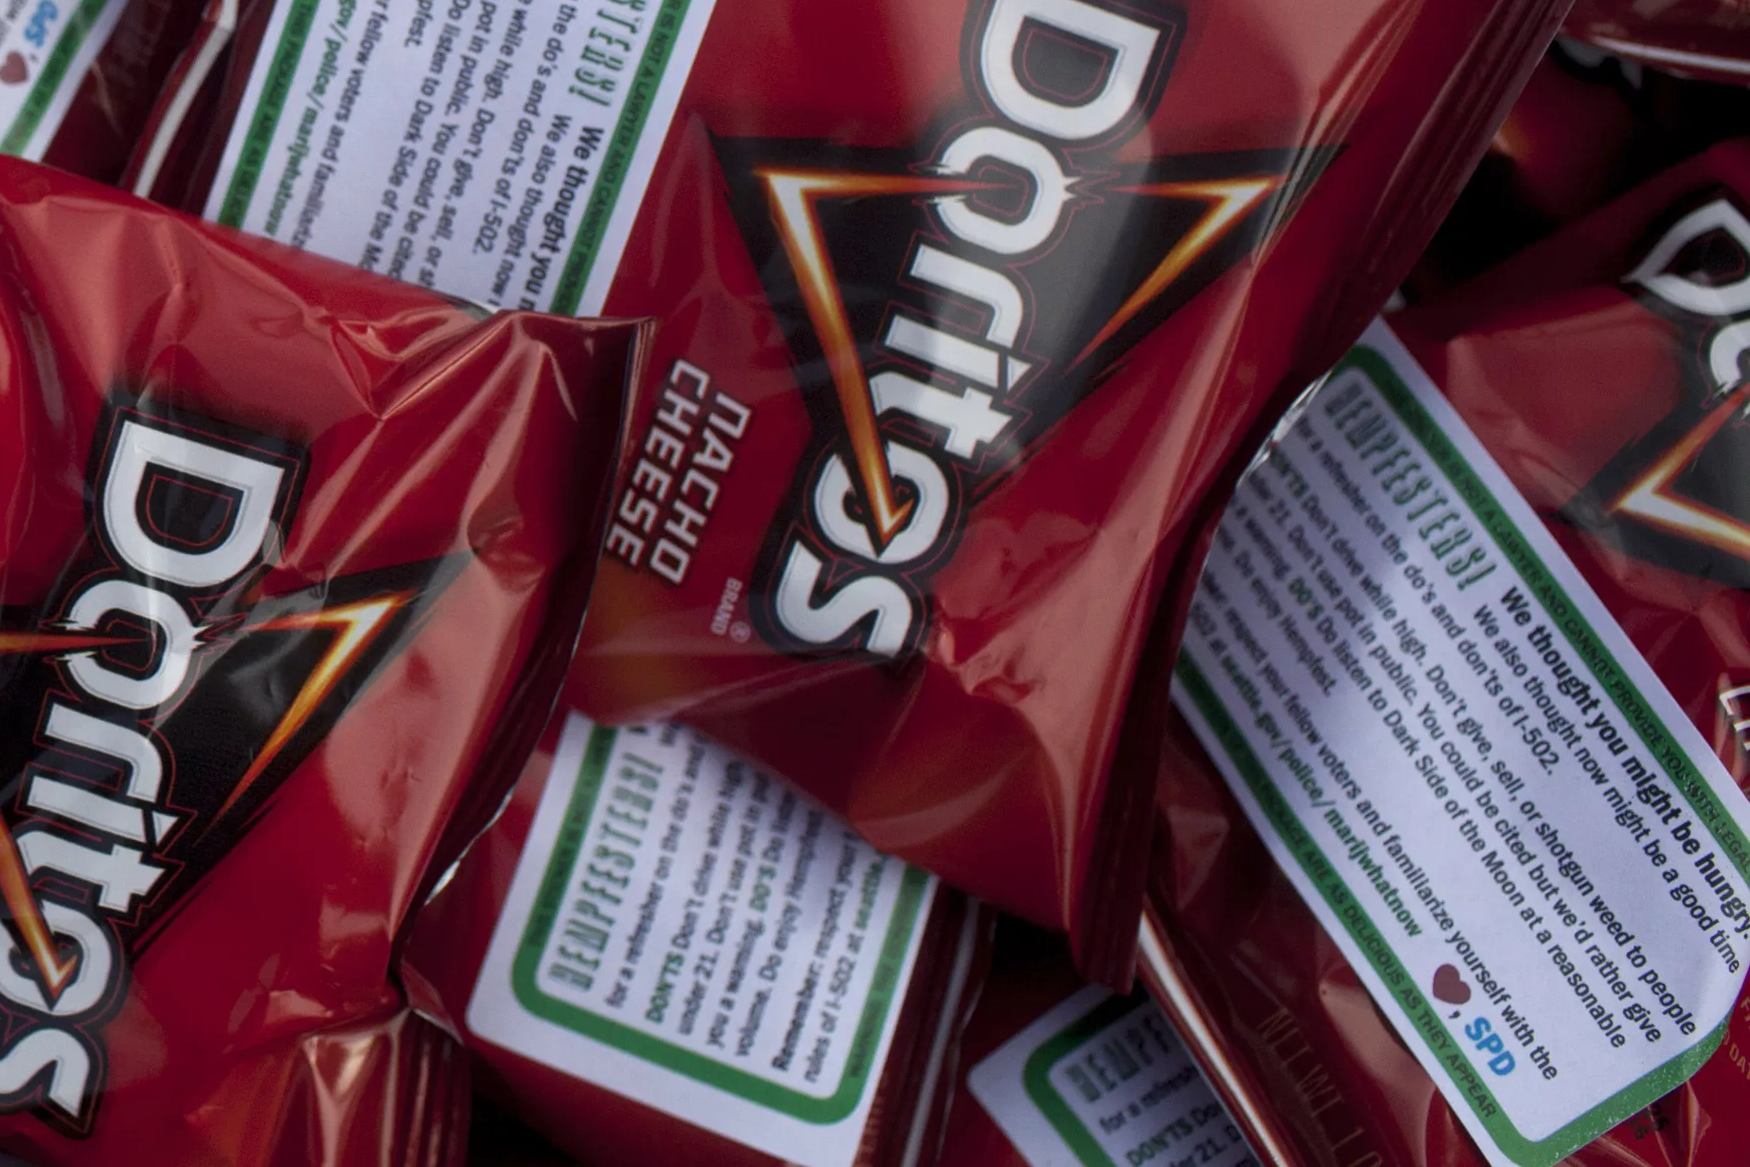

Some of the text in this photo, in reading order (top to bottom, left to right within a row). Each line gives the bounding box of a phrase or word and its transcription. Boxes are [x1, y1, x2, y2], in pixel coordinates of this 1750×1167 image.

[355, 10, 389, 67] fellow
[334, 68, 365, 123] voters
[321, 124, 345, 163] and
[573, 125, 605, 161] We
[538, 164, 589, 254] thought
[524, 252, 552, 296] you
[605, 358, 712, 567] CHEESE
[649, 390, 753, 587] NACHO
[1472, 603, 1740, 974] We also thought now might be a good time
[1499, 585, 1532, 627] We
[1526, 624, 1602, 716] thought
[1583, 711, 1630, 757] you
[1620, 755, 1683, 826] might
[1669, 819, 1702, 856] be
[1693, 851, 1750, 941] hungry.
[1332, 640, 1627, 1049] listen to Dark Side of the Moon at a reasonable
[1464, 1016, 1517, 1077] SPD
